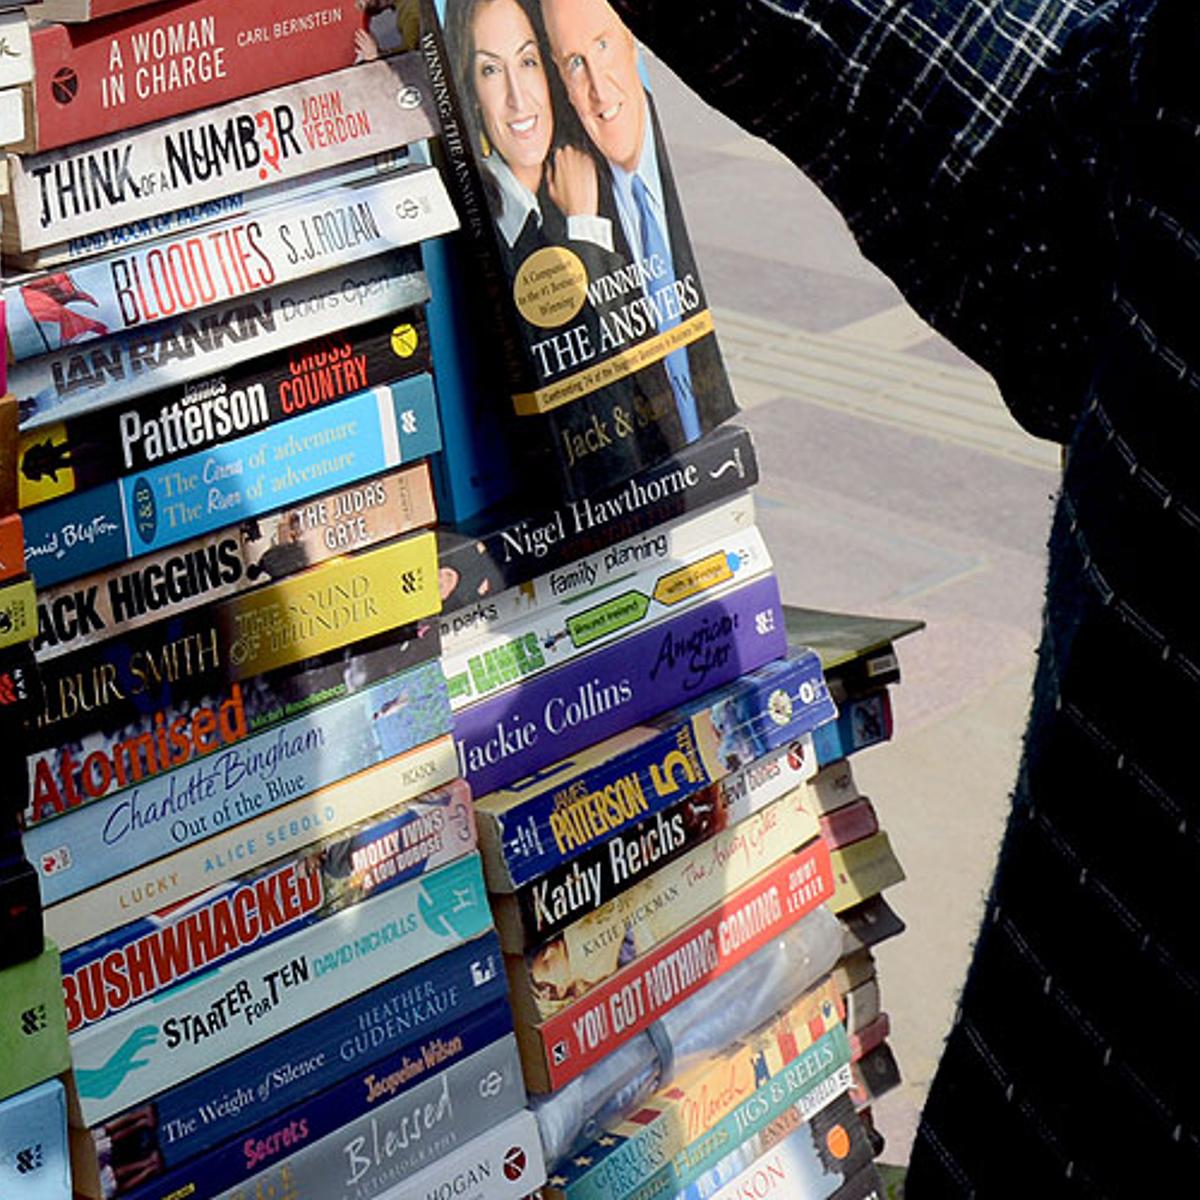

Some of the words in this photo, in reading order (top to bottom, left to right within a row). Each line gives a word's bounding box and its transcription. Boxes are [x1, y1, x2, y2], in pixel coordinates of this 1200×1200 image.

[131, 17, 215, 61] WOMAN
[237, 26, 269, 47] CARL
[273, 8, 342, 36] BERNSTEIN
[135, 48, 226, 99] CHARGE
[302, 90, 344, 121] JOHN
[302, 111, 371, 151] VERDON
[32, 144, 142, 228] THINK
[586, 252, 666, 309] WINNING:
[126, 298, 277, 371] RANKIN
[599, 274, 700, 354] ANSWERS
[279, 353, 370, 410] COUNTRY
[331, 482, 387, 515] JUDAS
[569, 460, 700, 534] Hawthorne
[500, 511, 566, 562] Nigel
[603, 533, 669, 575] planning
[107, 537, 244, 621] HIGGINS
[549, 561, 599, 596] family
[543, 675, 634, 733] Collins
[31, 681, 247, 822] Atomised
[220, 727, 325, 788] Bingham
[267, 772, 305, 805] Blue
[266, 805, 337, 847] SEBOLD
[608, 812, 686, 884] Reichs
[533, 861, 601, 933] Kathy
[719, 886, 782, 959] COMING
[62, 862, 322, 1034] BUSHWHACKED
[646, 928, 719, 1010] NOTHING
[162, 979, 253, 1049] STARTER
[339, 986, 460, 1063] GUDENKAUF
[272, 1051, 326, 1086] Silence
[243, 1117, 310, 1169] Secrets
